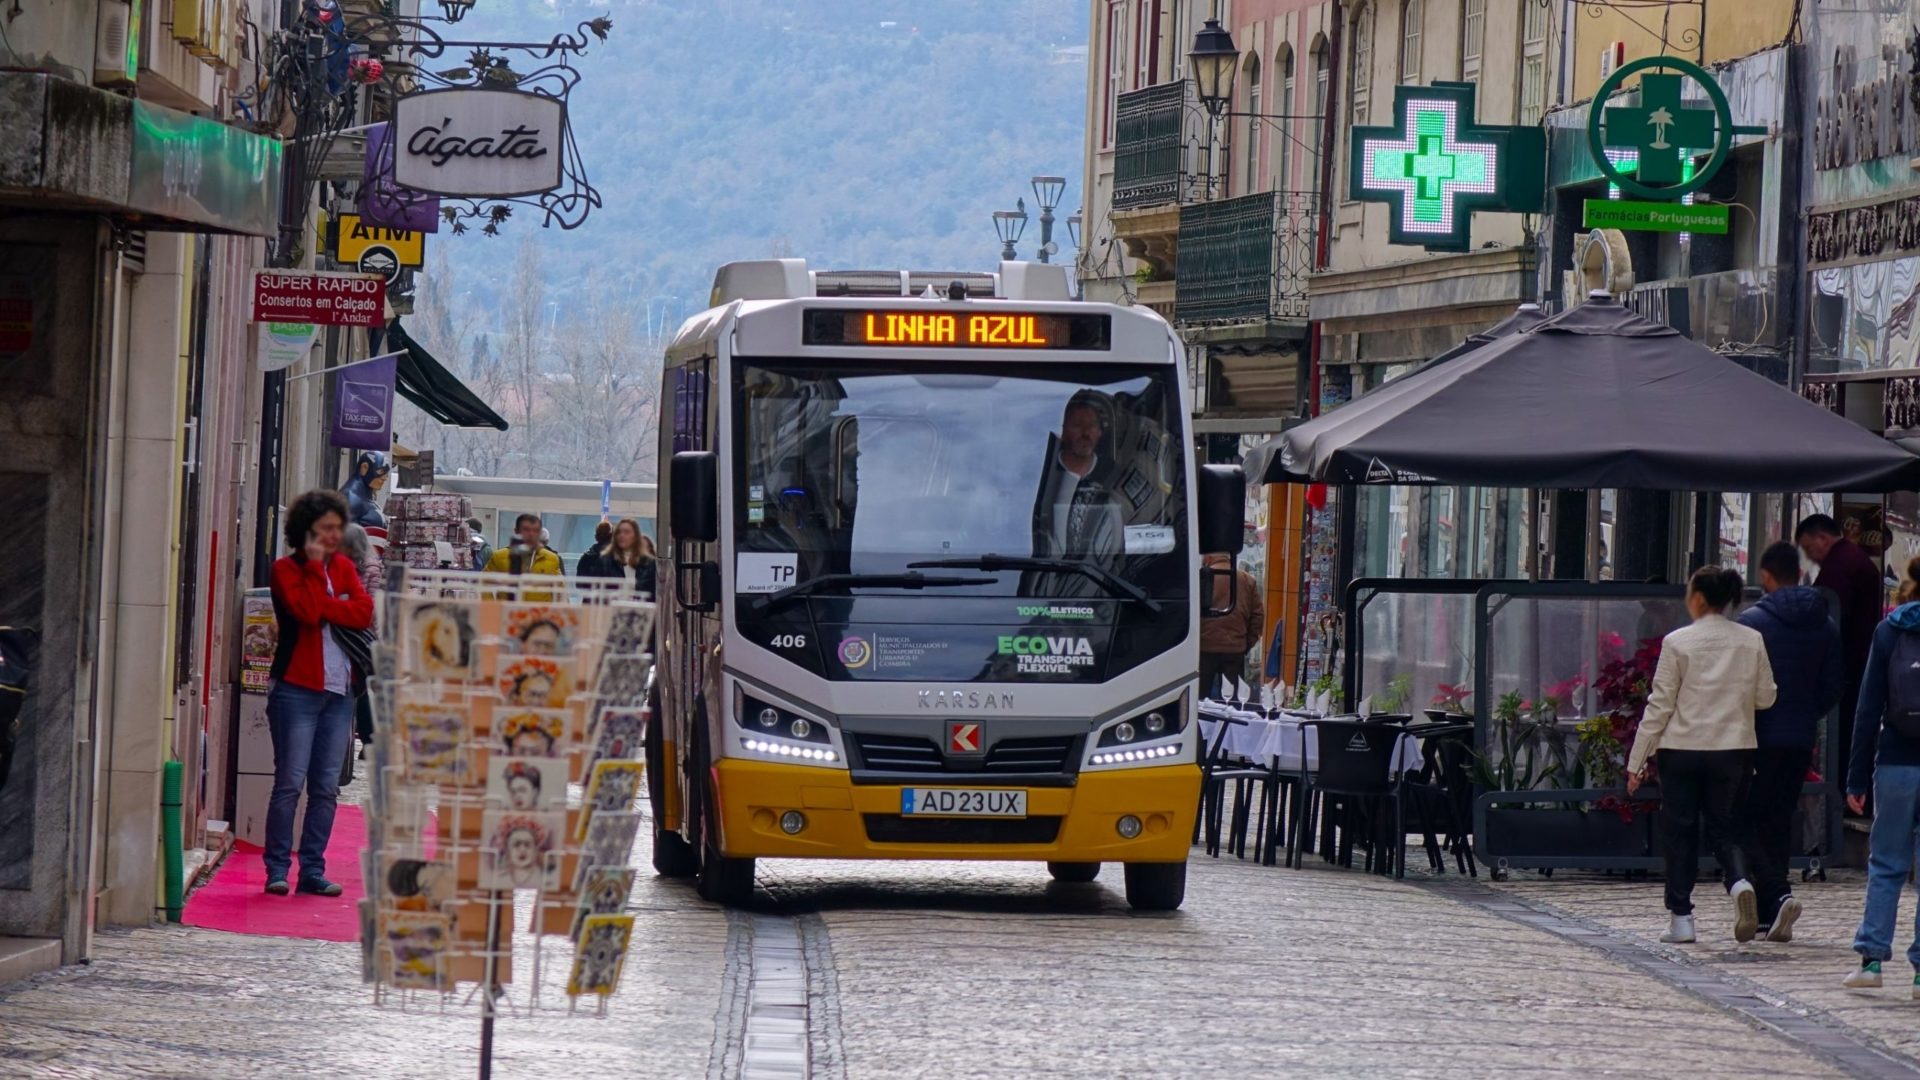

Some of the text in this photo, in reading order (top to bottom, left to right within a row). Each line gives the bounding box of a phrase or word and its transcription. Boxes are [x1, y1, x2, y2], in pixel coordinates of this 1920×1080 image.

[259, 275, 378, 293] SUPER RAPIDO
[259, 293, 377, 313] Consertos em Calçado
[341, 312, 372, 323] Andar
[865, 314, 1046, 343] LINHA AZUL
[344, 413, 379, 424] TAX-FREE
[770, 565, 795, 582] TP
[770, 634, 806, 648] 406
[997, 635, 1094, 656] ECOVIA
[1017, 655, 1095, 665] TRANSPORTE
[918, 690, 1014, 709] KARSAN
